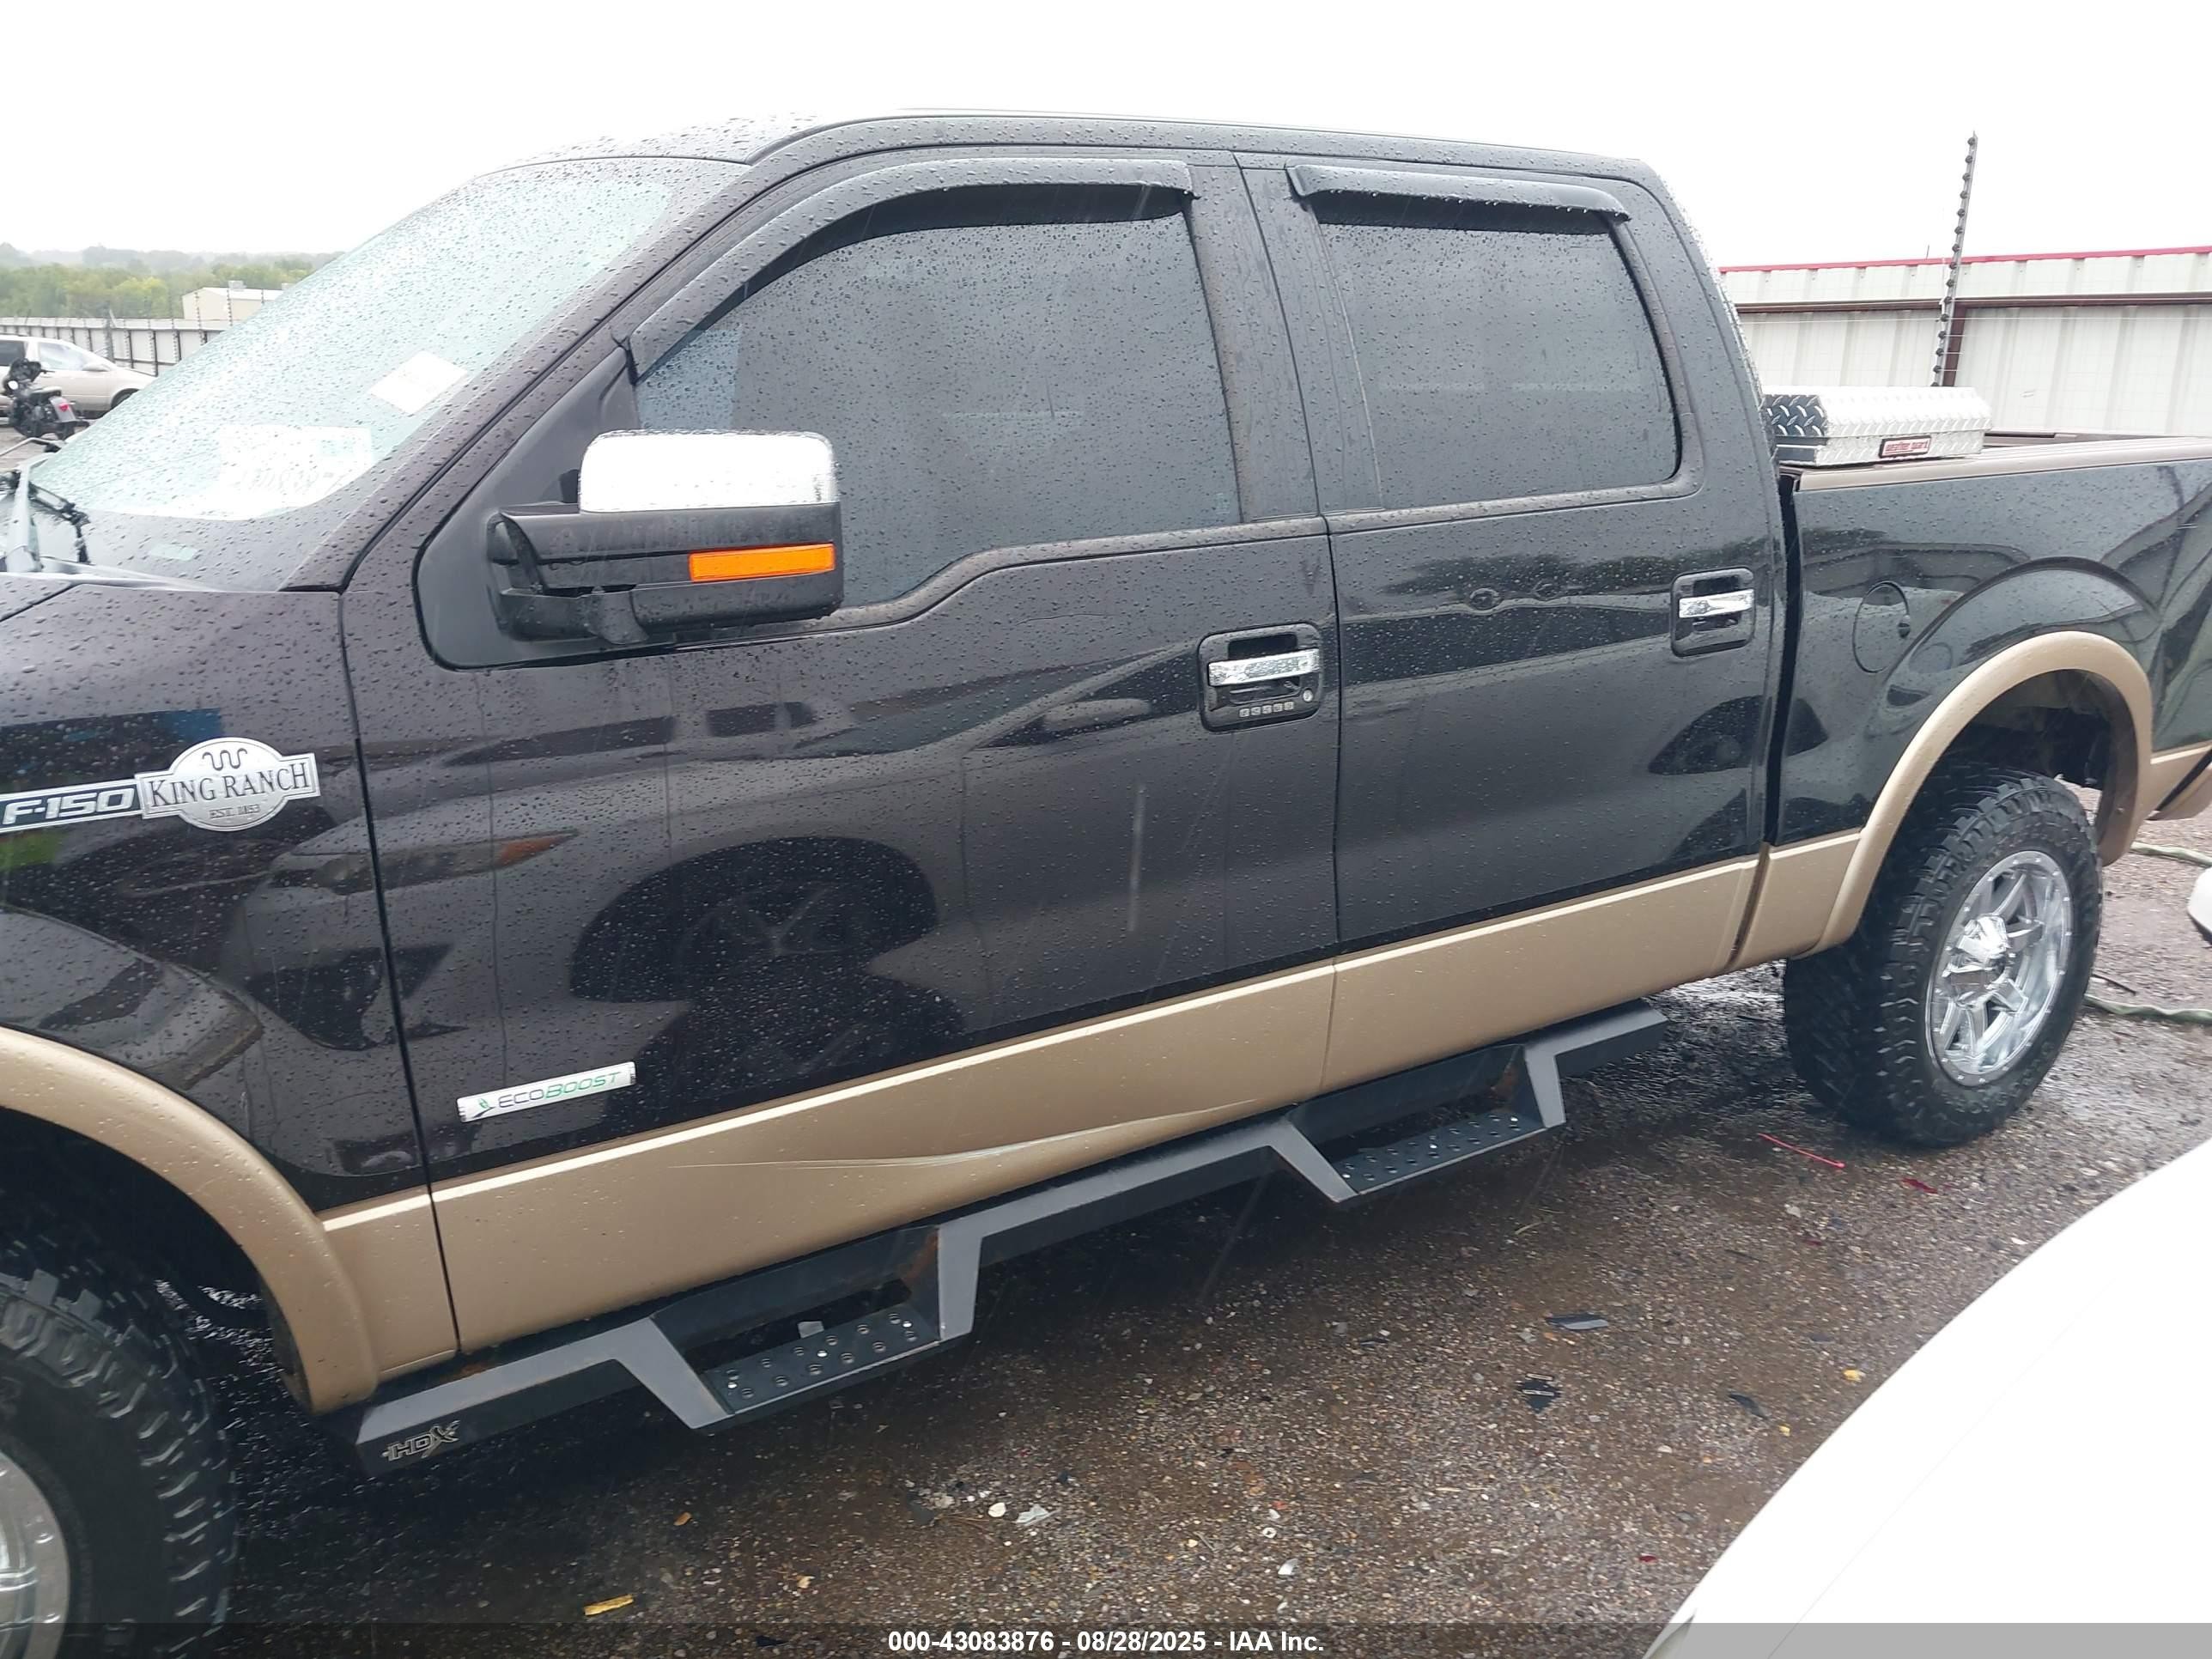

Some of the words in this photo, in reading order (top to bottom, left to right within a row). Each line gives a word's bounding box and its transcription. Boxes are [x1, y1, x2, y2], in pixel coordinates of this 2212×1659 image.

[3, 787, 135, 824] F-150
[149, 776, 216, 808] KING
[224, 762, 311, 799] RANCH
[382, 1419, 461, 1462] HDX
